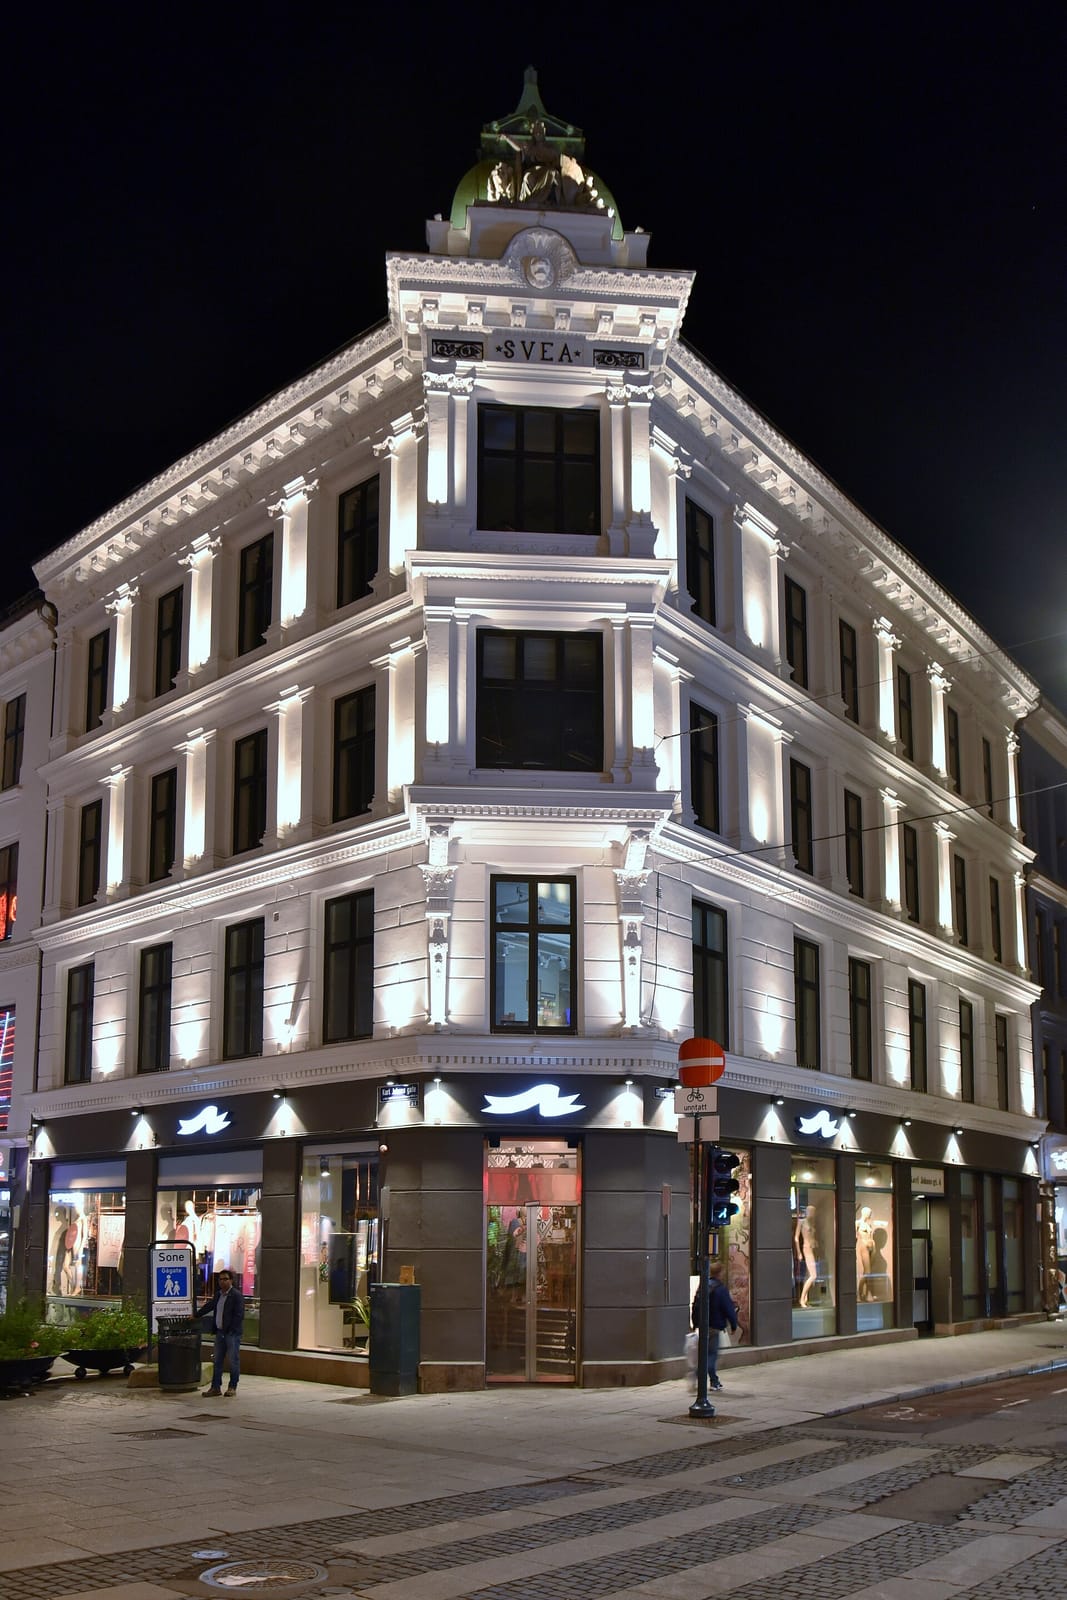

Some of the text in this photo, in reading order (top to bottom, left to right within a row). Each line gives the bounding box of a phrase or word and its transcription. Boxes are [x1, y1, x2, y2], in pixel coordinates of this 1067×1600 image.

[503, 340, 573, 363] SVEA
[683, 1103, 707, 1111] unntatt
[158, 1252, 185, 1262] Sone
[161, 1267, 182, 1275] Gågate
